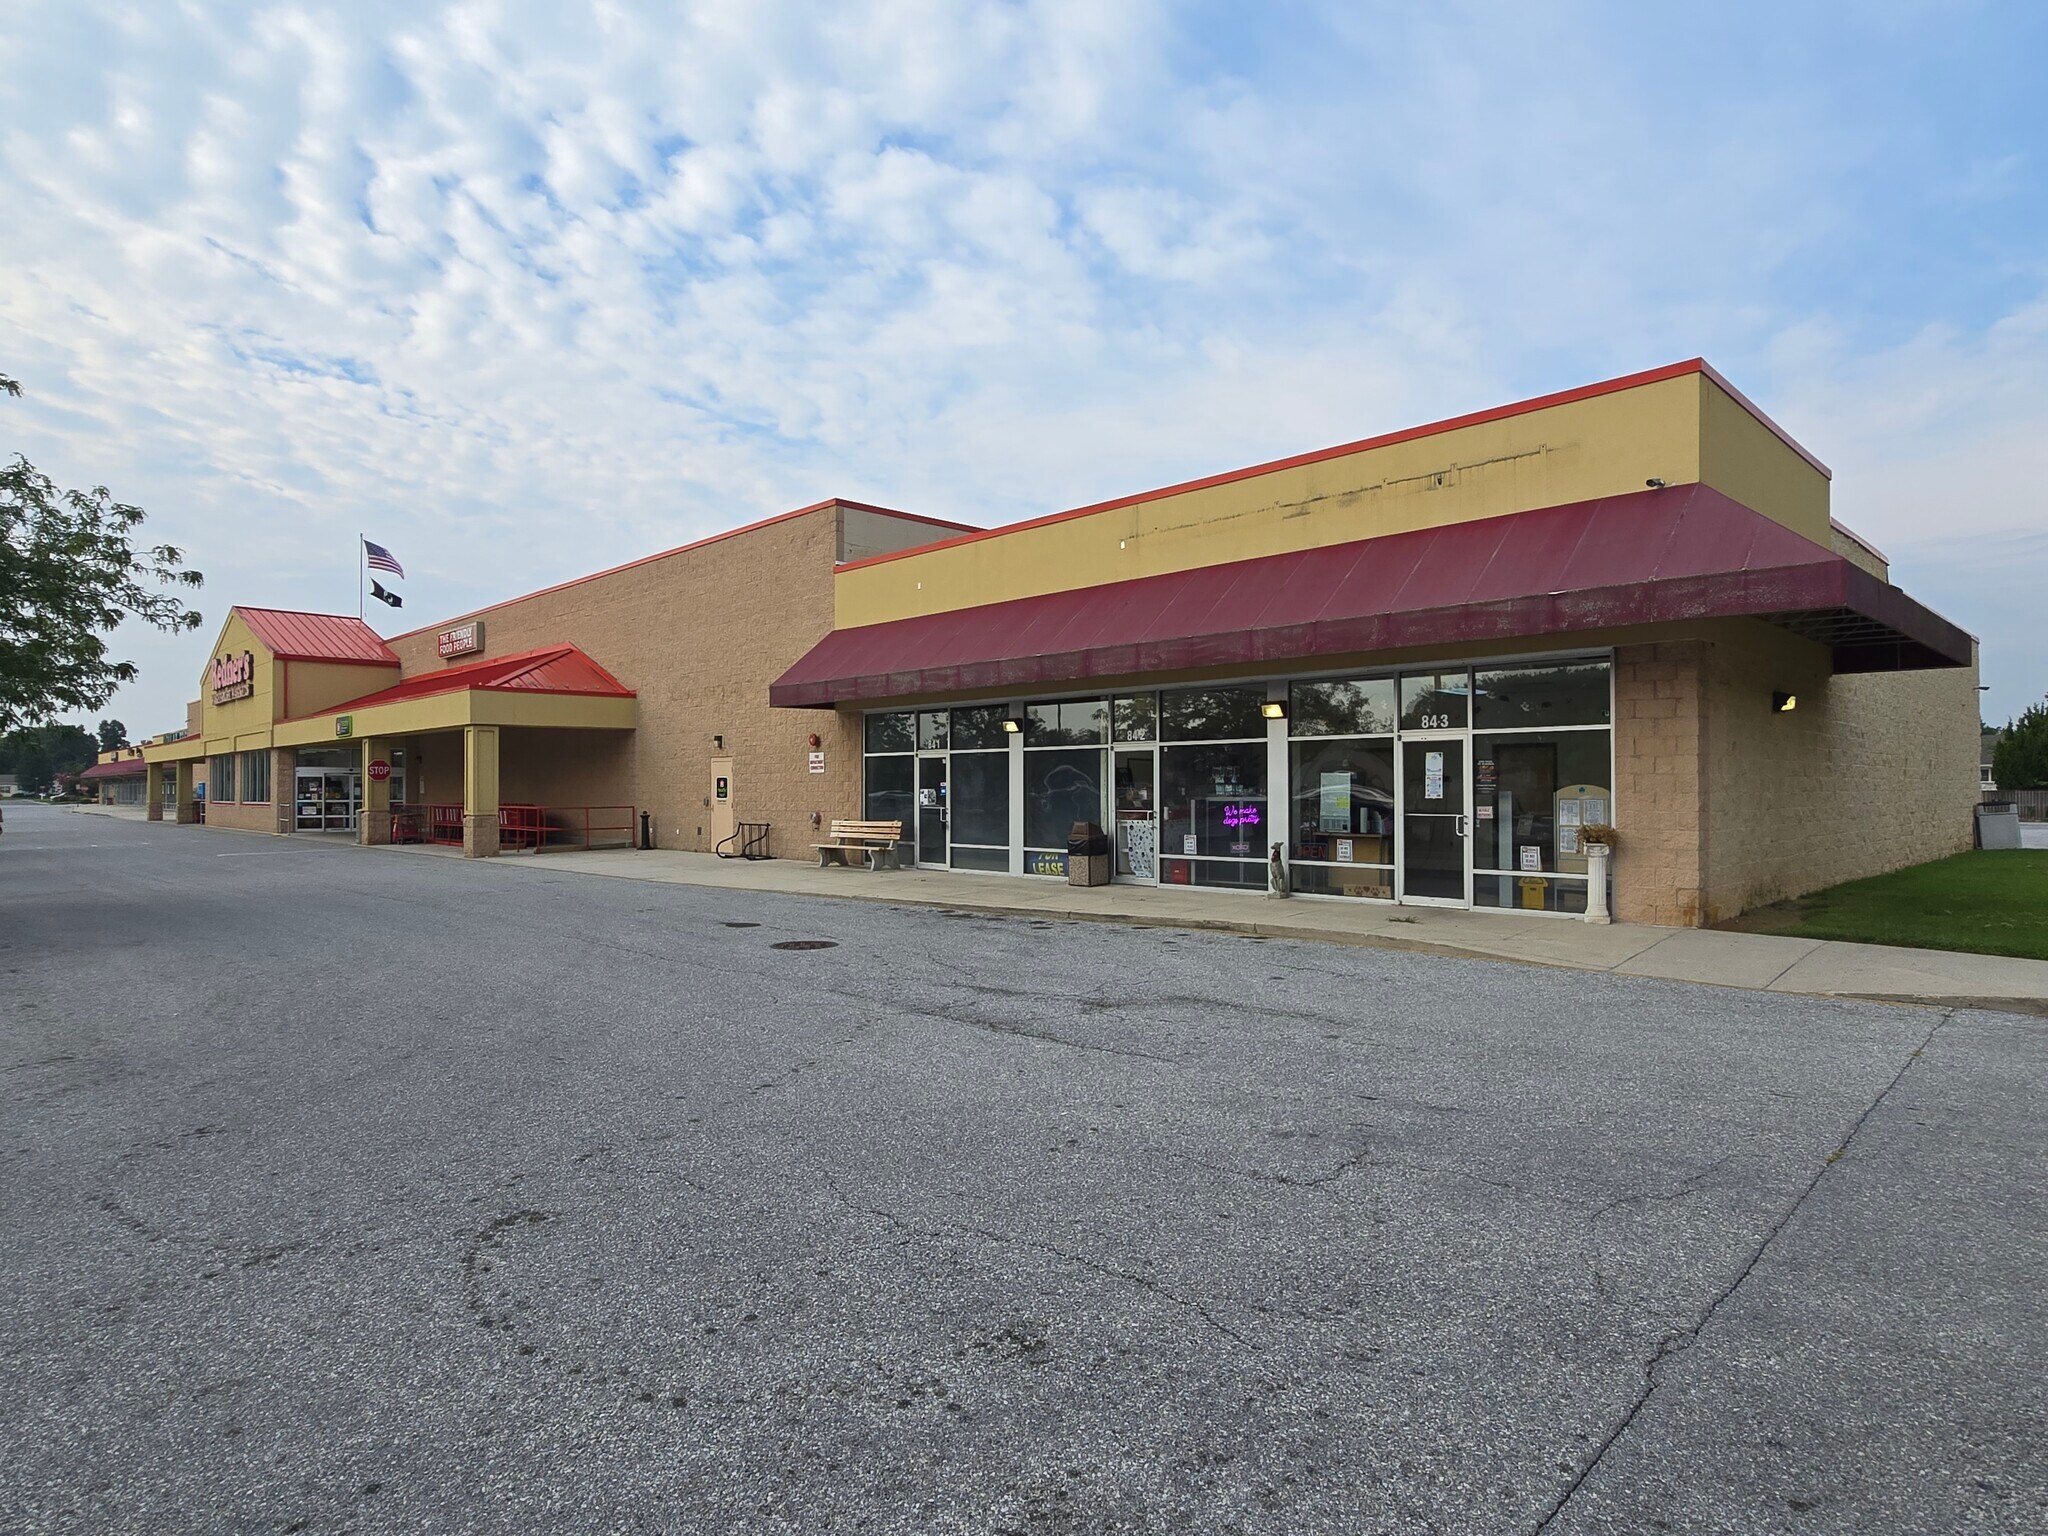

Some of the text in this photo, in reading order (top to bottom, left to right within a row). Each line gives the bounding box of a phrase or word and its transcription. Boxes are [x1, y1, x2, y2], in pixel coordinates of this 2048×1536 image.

[439, 627, 472, 644] THE FRIENDLY
[439, 637, 473, 655] FOOD PEOPLE
[1421, 714, 1449, 729] 843
[1127, 730, 1146, 741] 842
[369, 766, 390, 775] STOP
[1295, 844, 1326, 858] OPEN
[1032, 862, 1065, 876] LEASE
